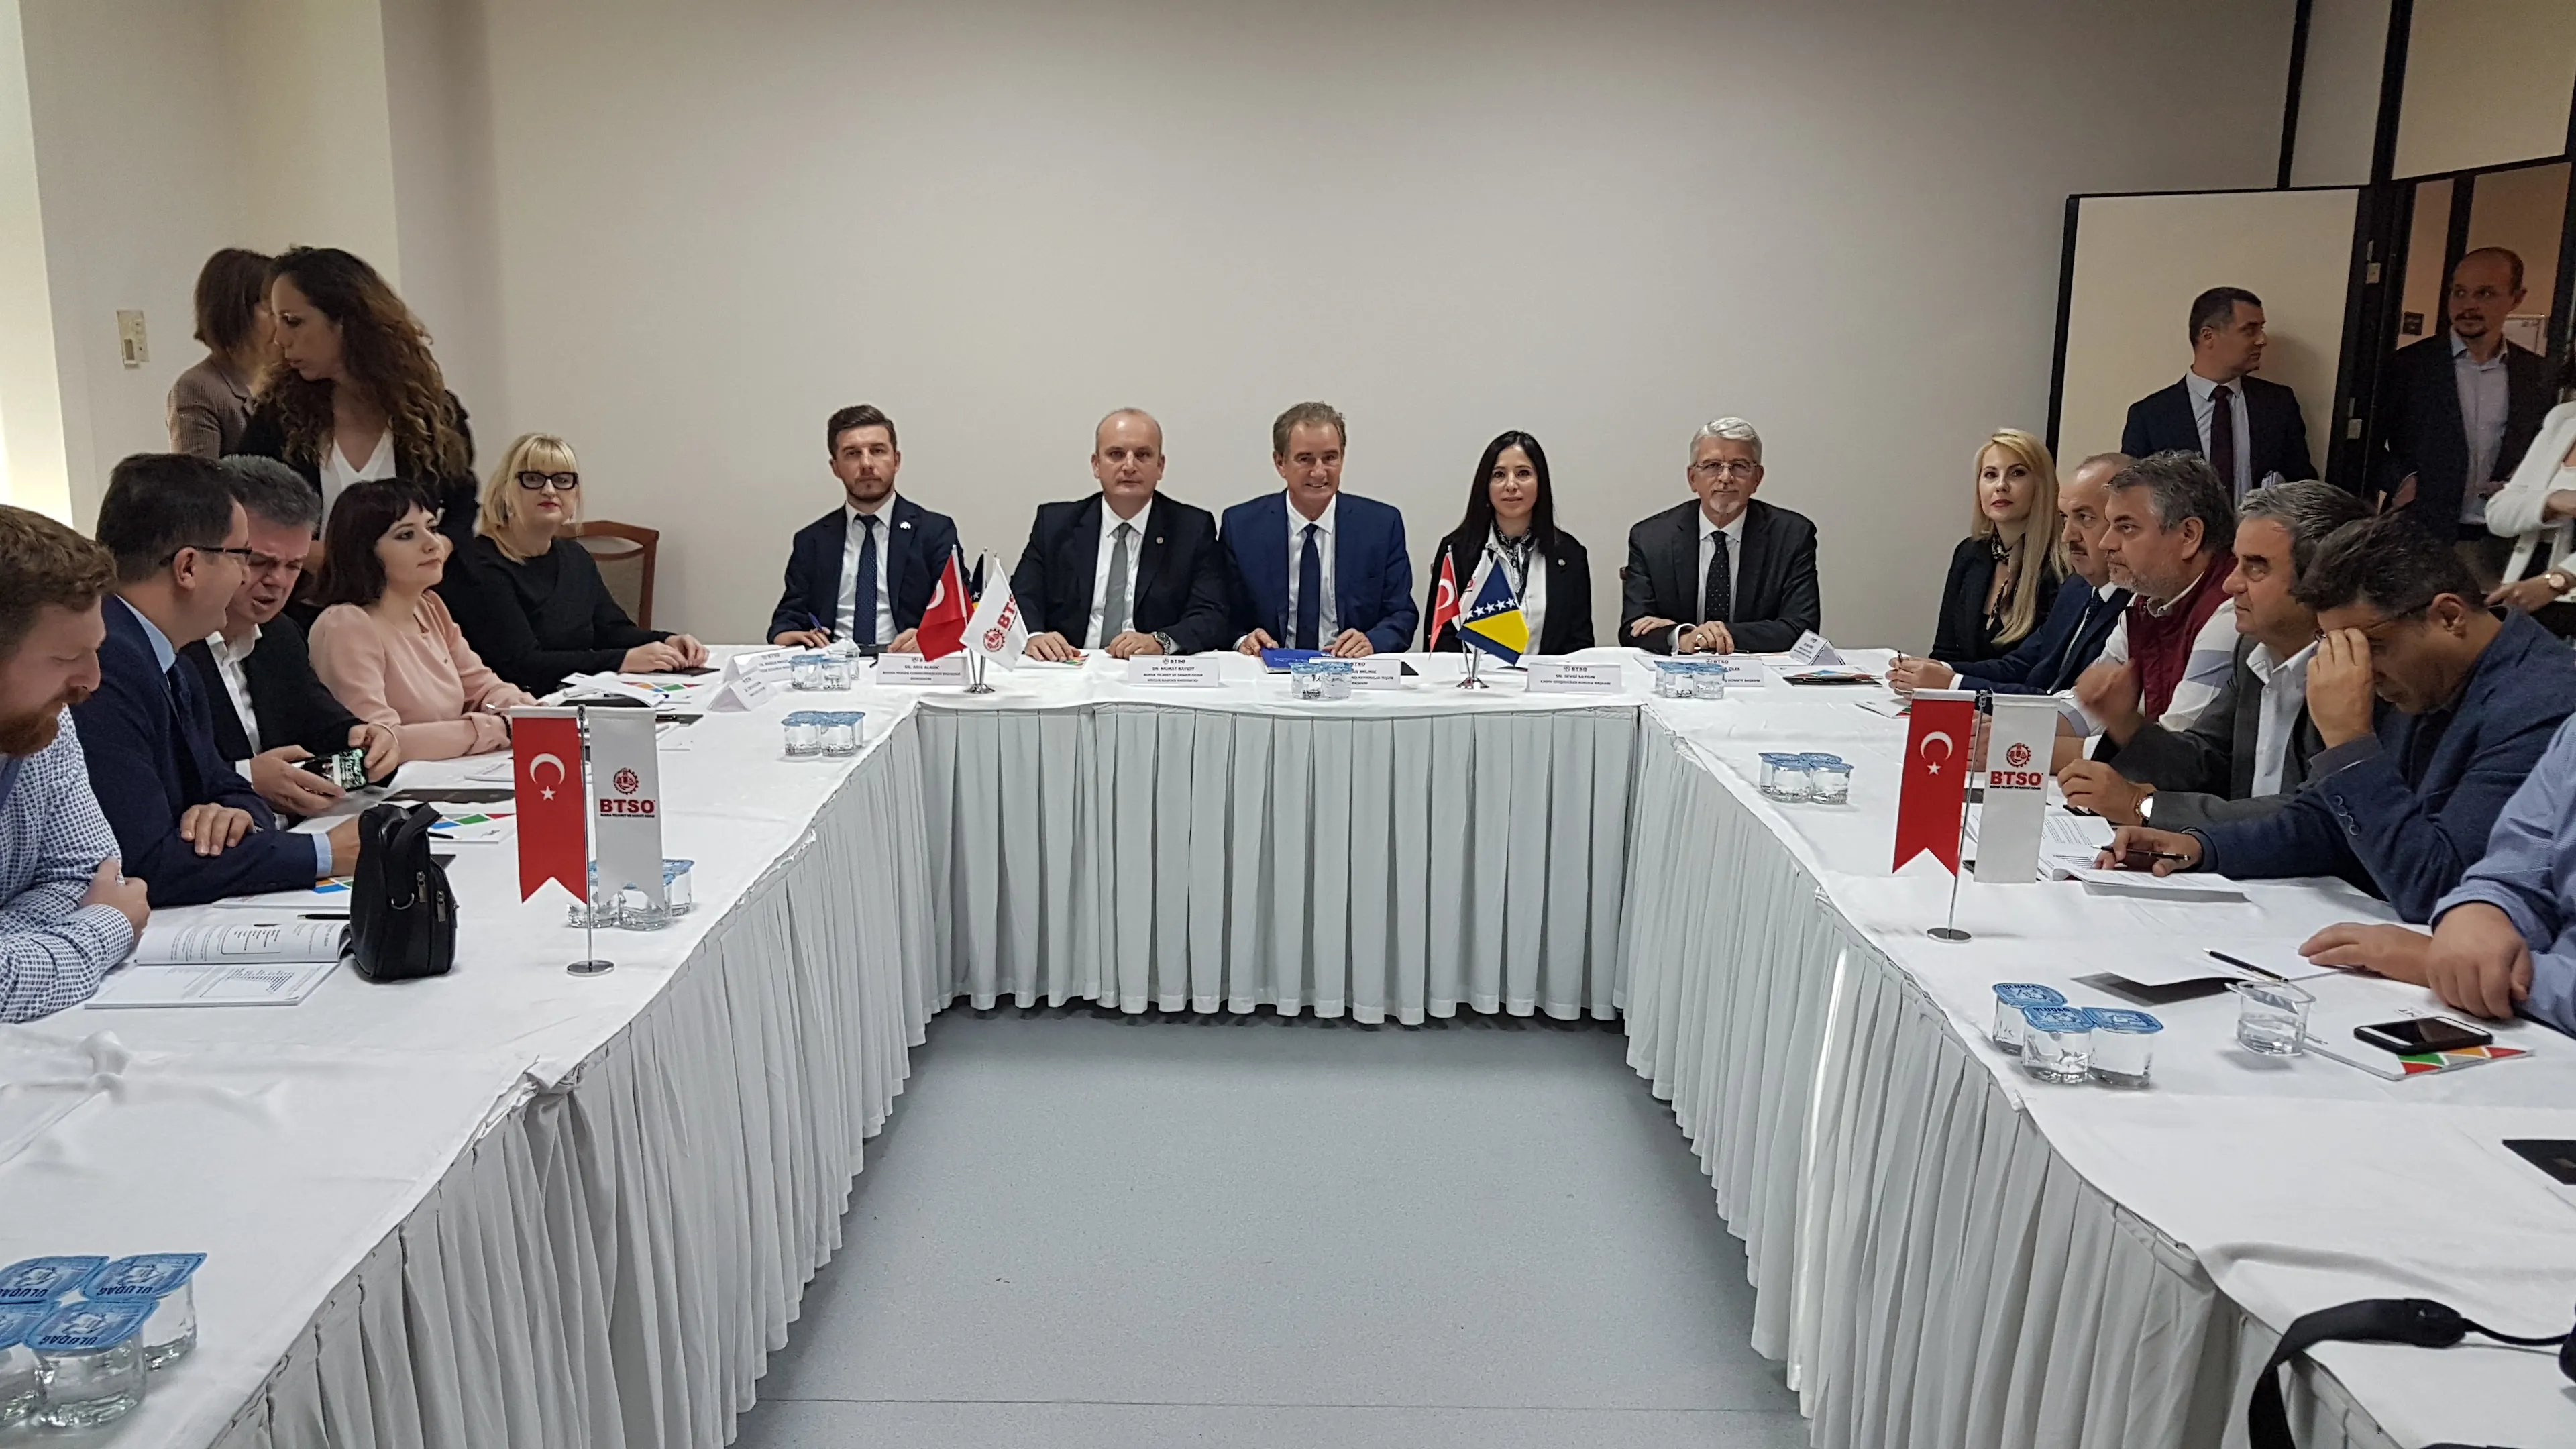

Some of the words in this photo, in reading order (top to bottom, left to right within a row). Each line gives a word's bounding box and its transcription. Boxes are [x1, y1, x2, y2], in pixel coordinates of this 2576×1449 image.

[997, 594, 1016, 629] BT
[1990, 771, 2041, 786] BTSO
[600, 799, 655, 813] BTSO
